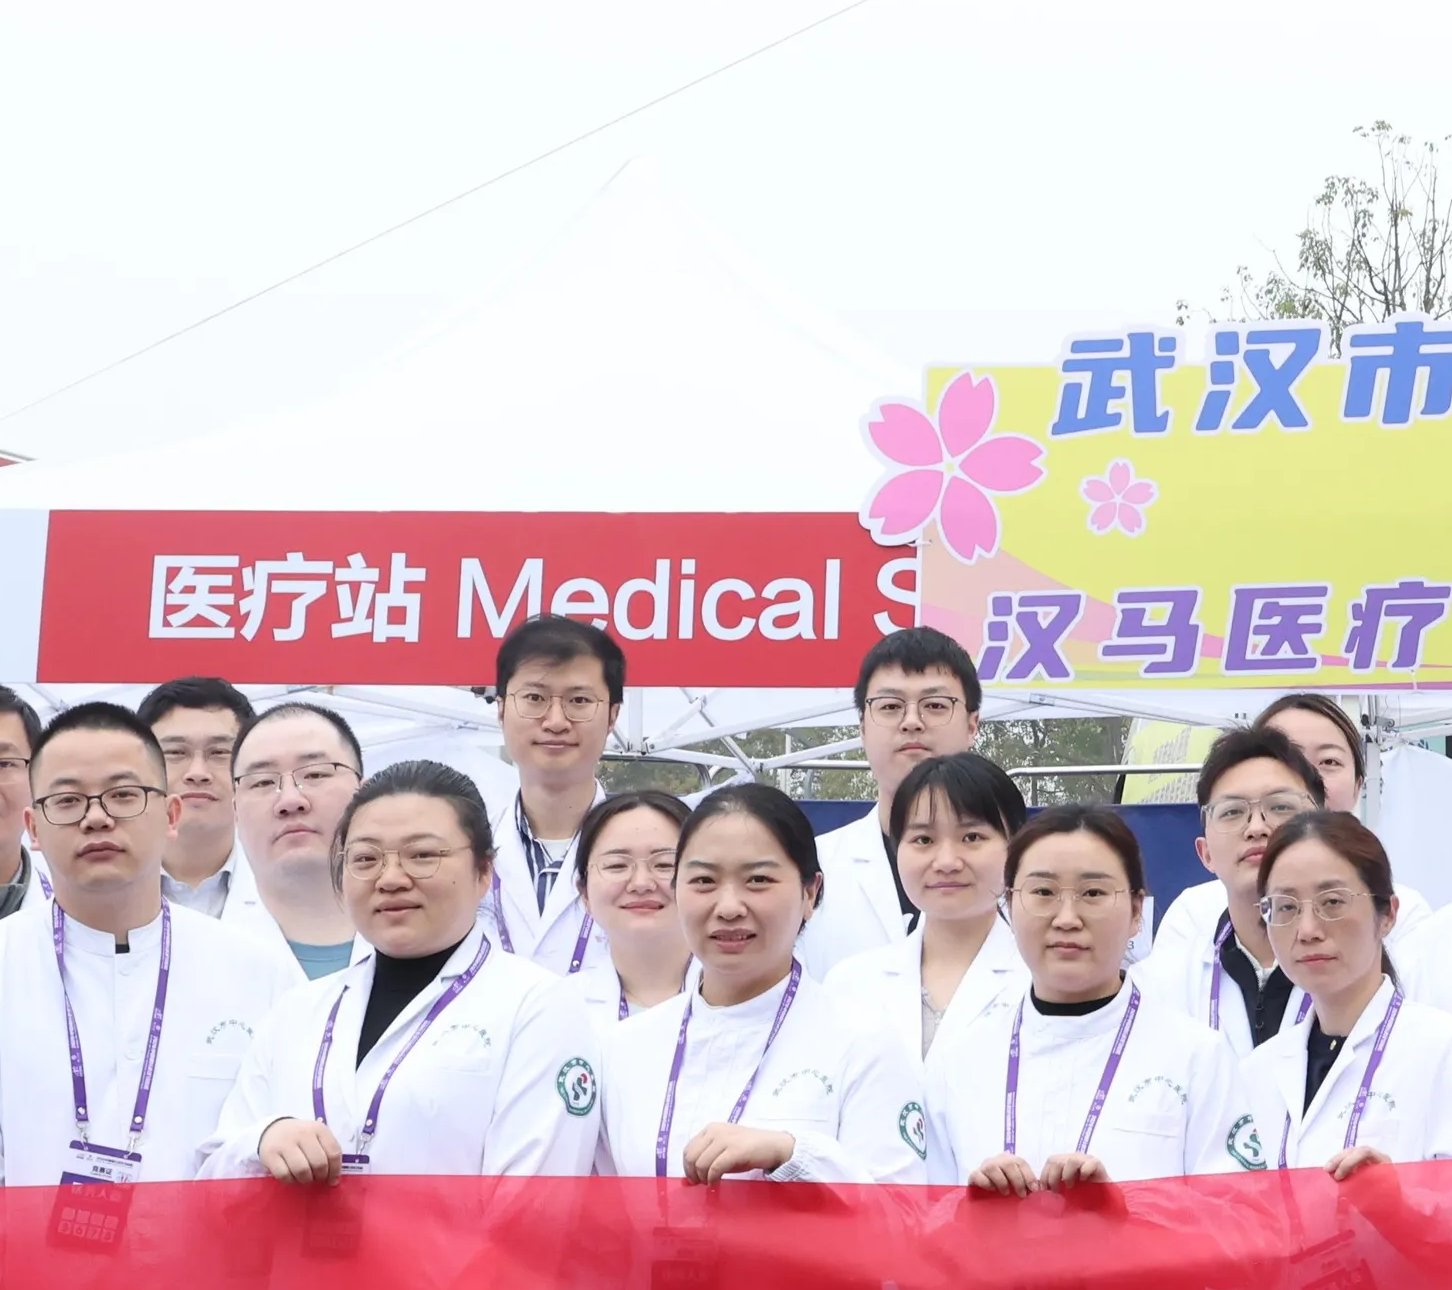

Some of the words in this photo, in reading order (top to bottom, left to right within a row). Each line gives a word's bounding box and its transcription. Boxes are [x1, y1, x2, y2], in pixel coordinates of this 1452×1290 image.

[148, 552, 427, 644] 医疗站
[447, 557, 841, 641] Medical
